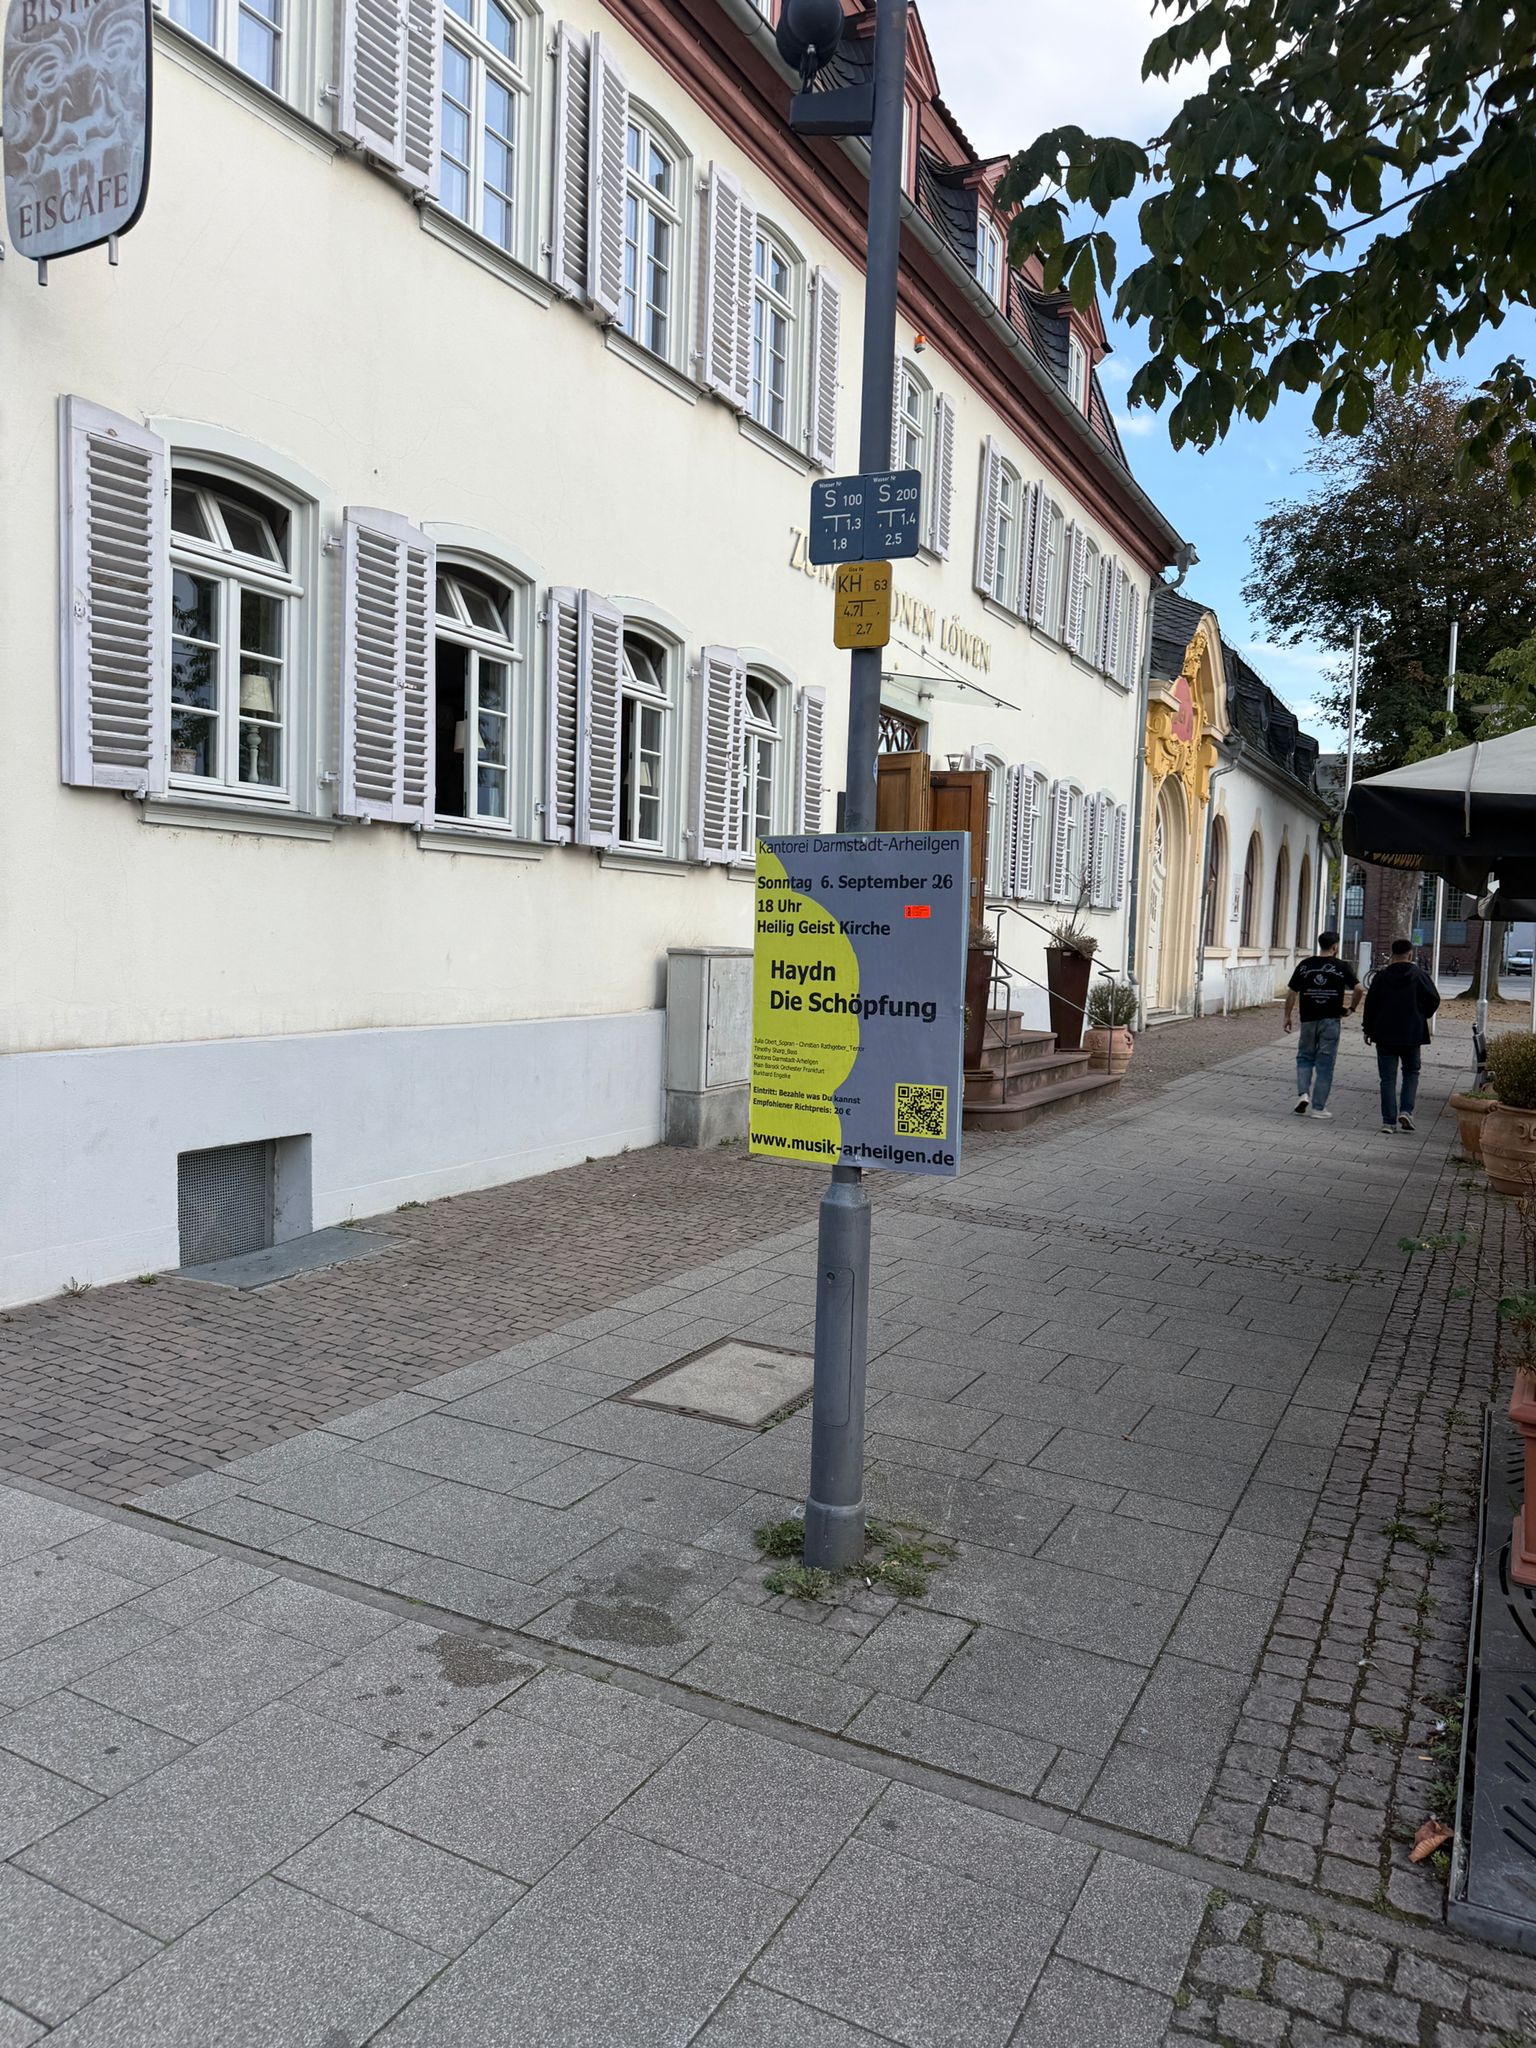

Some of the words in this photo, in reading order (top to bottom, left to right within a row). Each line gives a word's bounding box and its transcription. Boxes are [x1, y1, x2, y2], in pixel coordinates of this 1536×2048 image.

[22, 0, 100, 34] BIS
[19, 172, 129, 239] EISCAFE
[824, 490, 836, 508] S
[843, 494, 863, 506] 100
[879, 484, 891, 503] S
[896, 488, 918, 501] 200
[838, 574, 862, 593] KH
[874, 579, 888, 591] 63
[940, 612, 992, 674] LÖWEN
[759, 839, 808, 854] Kantorei
[813, 836, 960, 854] Darmstadt-Arheilgen
[758, 876, 812, 892] Sonntag
[820, 875, 834, 889] 6.
[838, 874, 927, 892] September
[932, 874, 953, 889] 26
[757, 900, 774, 913] 18
[778, 900, 802, 913] Uhr
[757, 920, 794, 936] Heilig
[798, 920, 835, 935] Geist
[840, 921, 891, 936] Kirche
[771, 960, 836, 986] Haydn
[770, 990, 802, 1011] Die
[808, 992, 937, 1023] Schöpfung
[753, 1086, 777, 1095] Eintritt:
[779, 1089, 805, 1098] Bezahle
[822, 1093, 832, 1101] Du
[834, 1094, 860, 1104] kannst
[753, 1098, 793, 1109] Empfohlener
[795, 1103, 832, 1114] Richtpreis:
[834, 1107, 843, 1115] 20
[845, 1108, 851, 1116] €
[751, 1132, 955, 1166] www.musik-arheilgen.de
